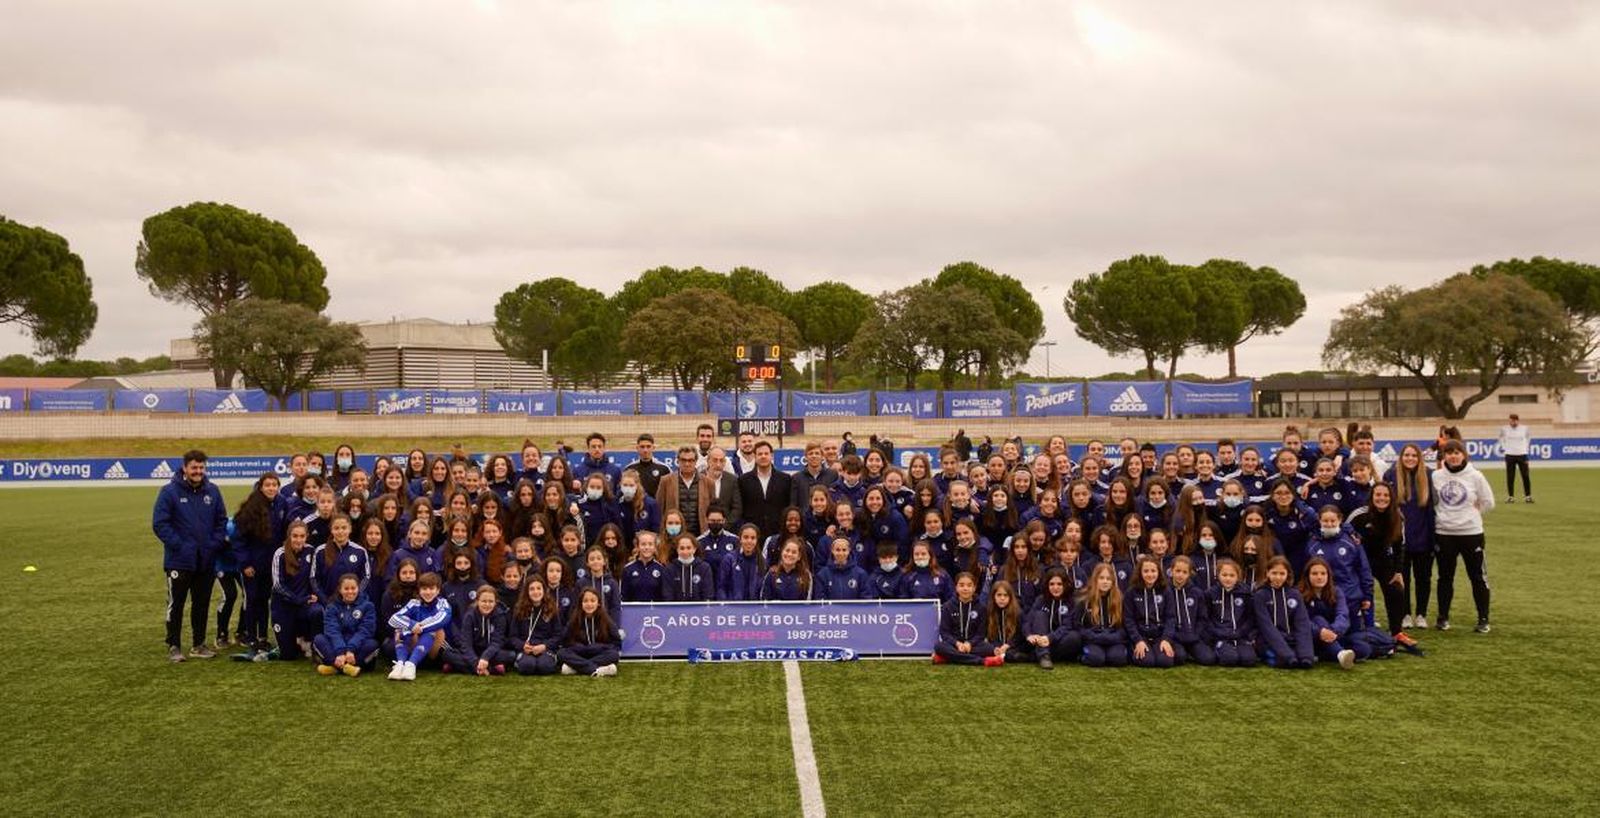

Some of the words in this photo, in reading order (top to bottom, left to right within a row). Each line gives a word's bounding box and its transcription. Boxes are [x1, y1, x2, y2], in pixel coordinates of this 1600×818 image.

[736, 346, 745, 358] 0
[772, 345, 780, 358] 0
[748, 367, 775, 379] 0:00
[497, 402, 525, 412] ALZA
[881, 403, 913, 414] ALZA
[1109, 402, 1148, 412] adidas
[667, 613, 712, 627] AÑOS
[717, 615, 737, 626] DE
[742, 612, 804, 627] FÚTBOL
[808, 614, 891, 626] FEMENINO
[786, 630, 849, 641] 1997-2022
